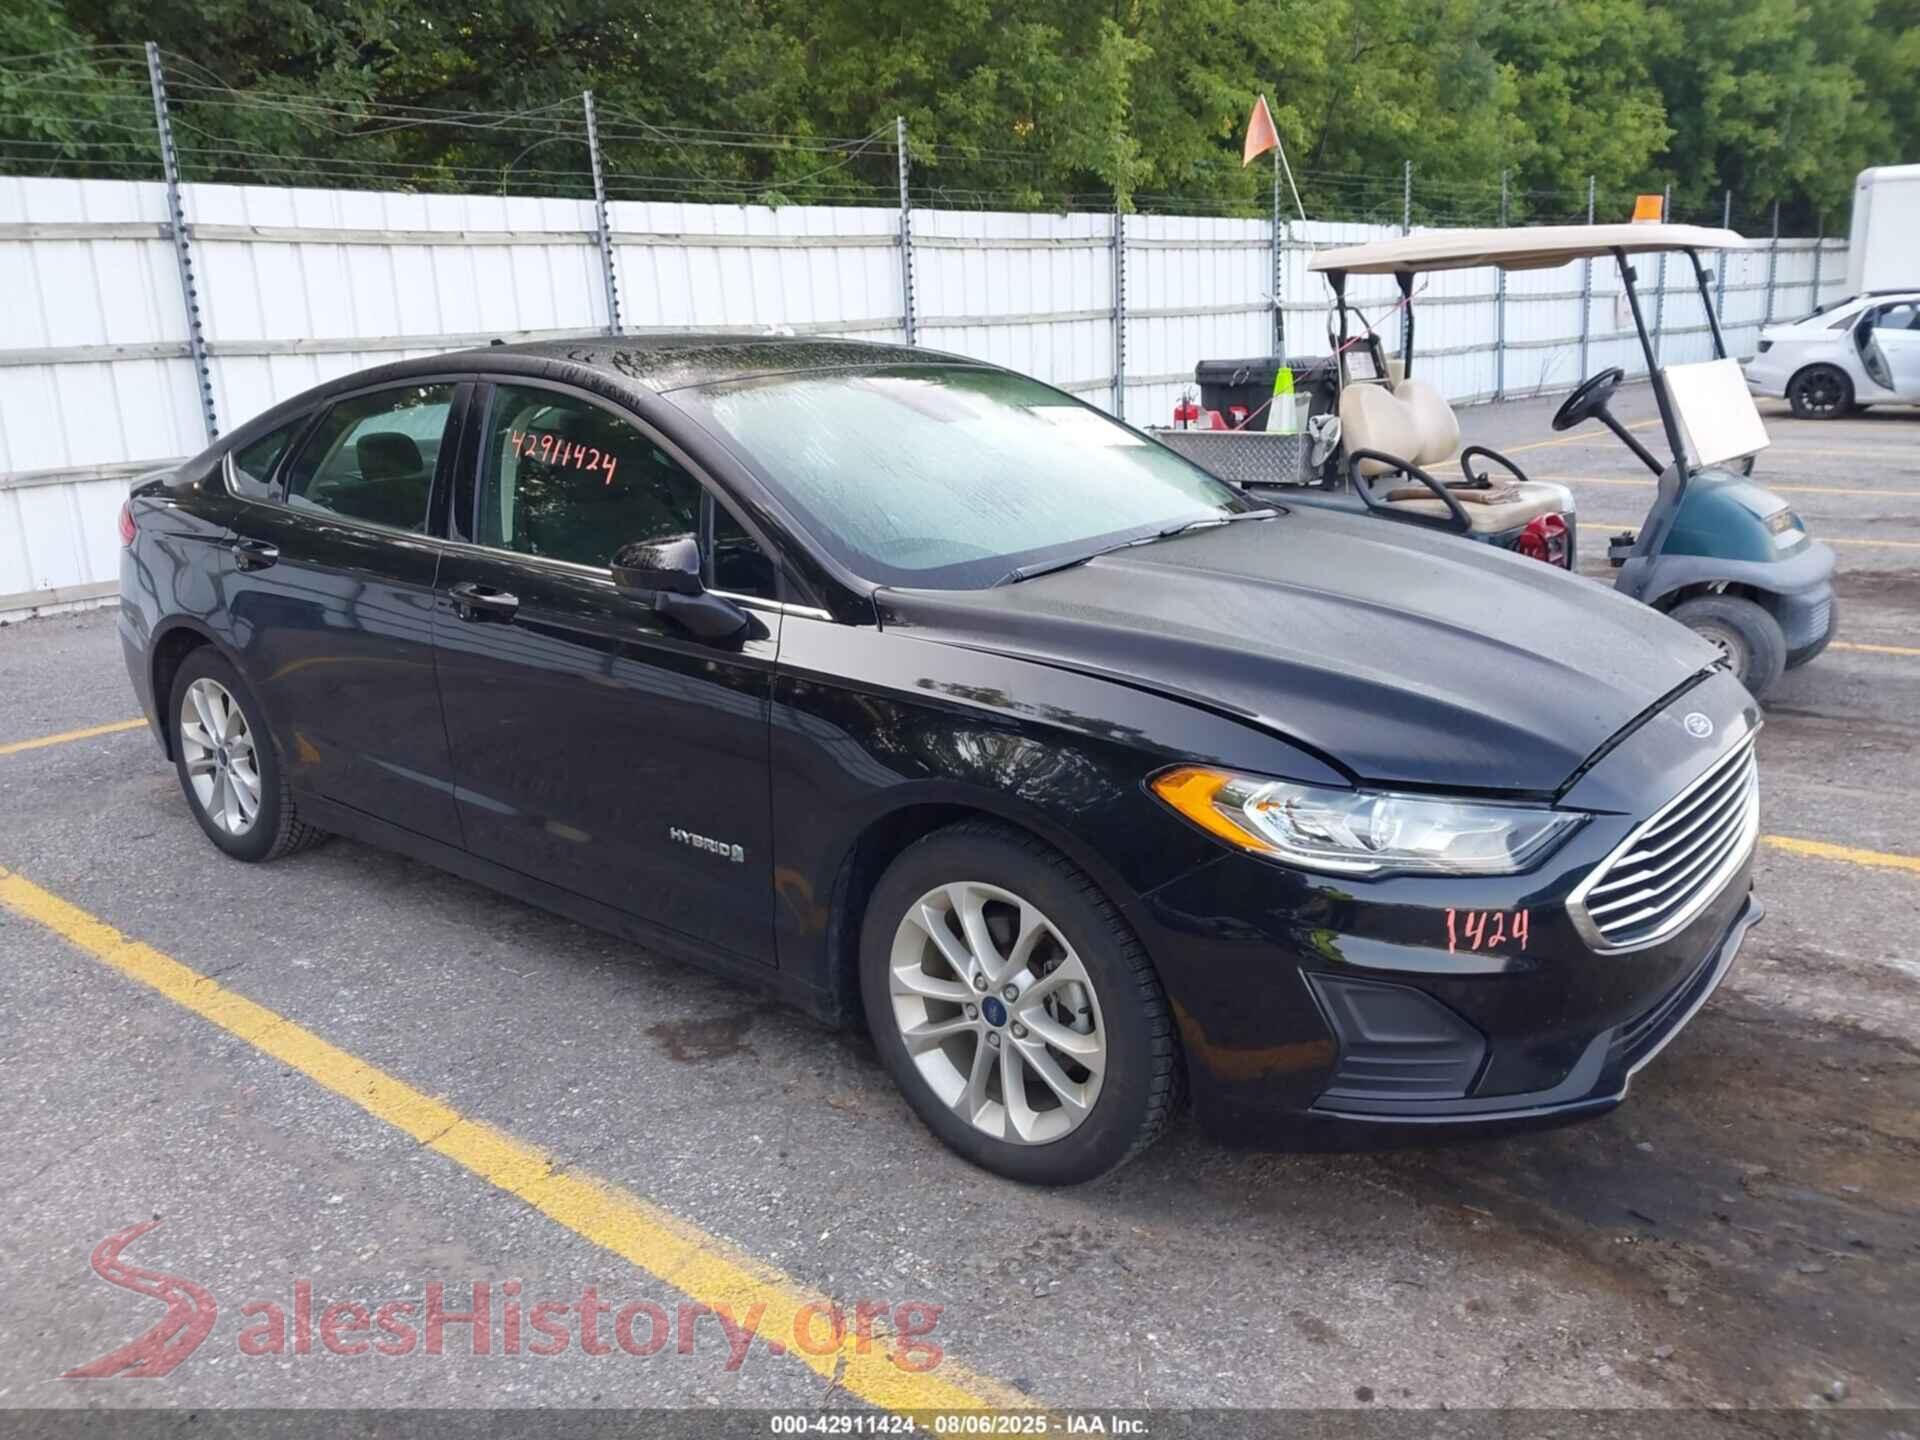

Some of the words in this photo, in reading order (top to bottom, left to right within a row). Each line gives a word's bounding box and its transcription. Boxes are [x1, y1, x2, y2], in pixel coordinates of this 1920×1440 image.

[511, 431, 617, 485] 42911424
[669, 826, 730, 857] HYBRID
[1445, 907, 1529, 954] 1424
